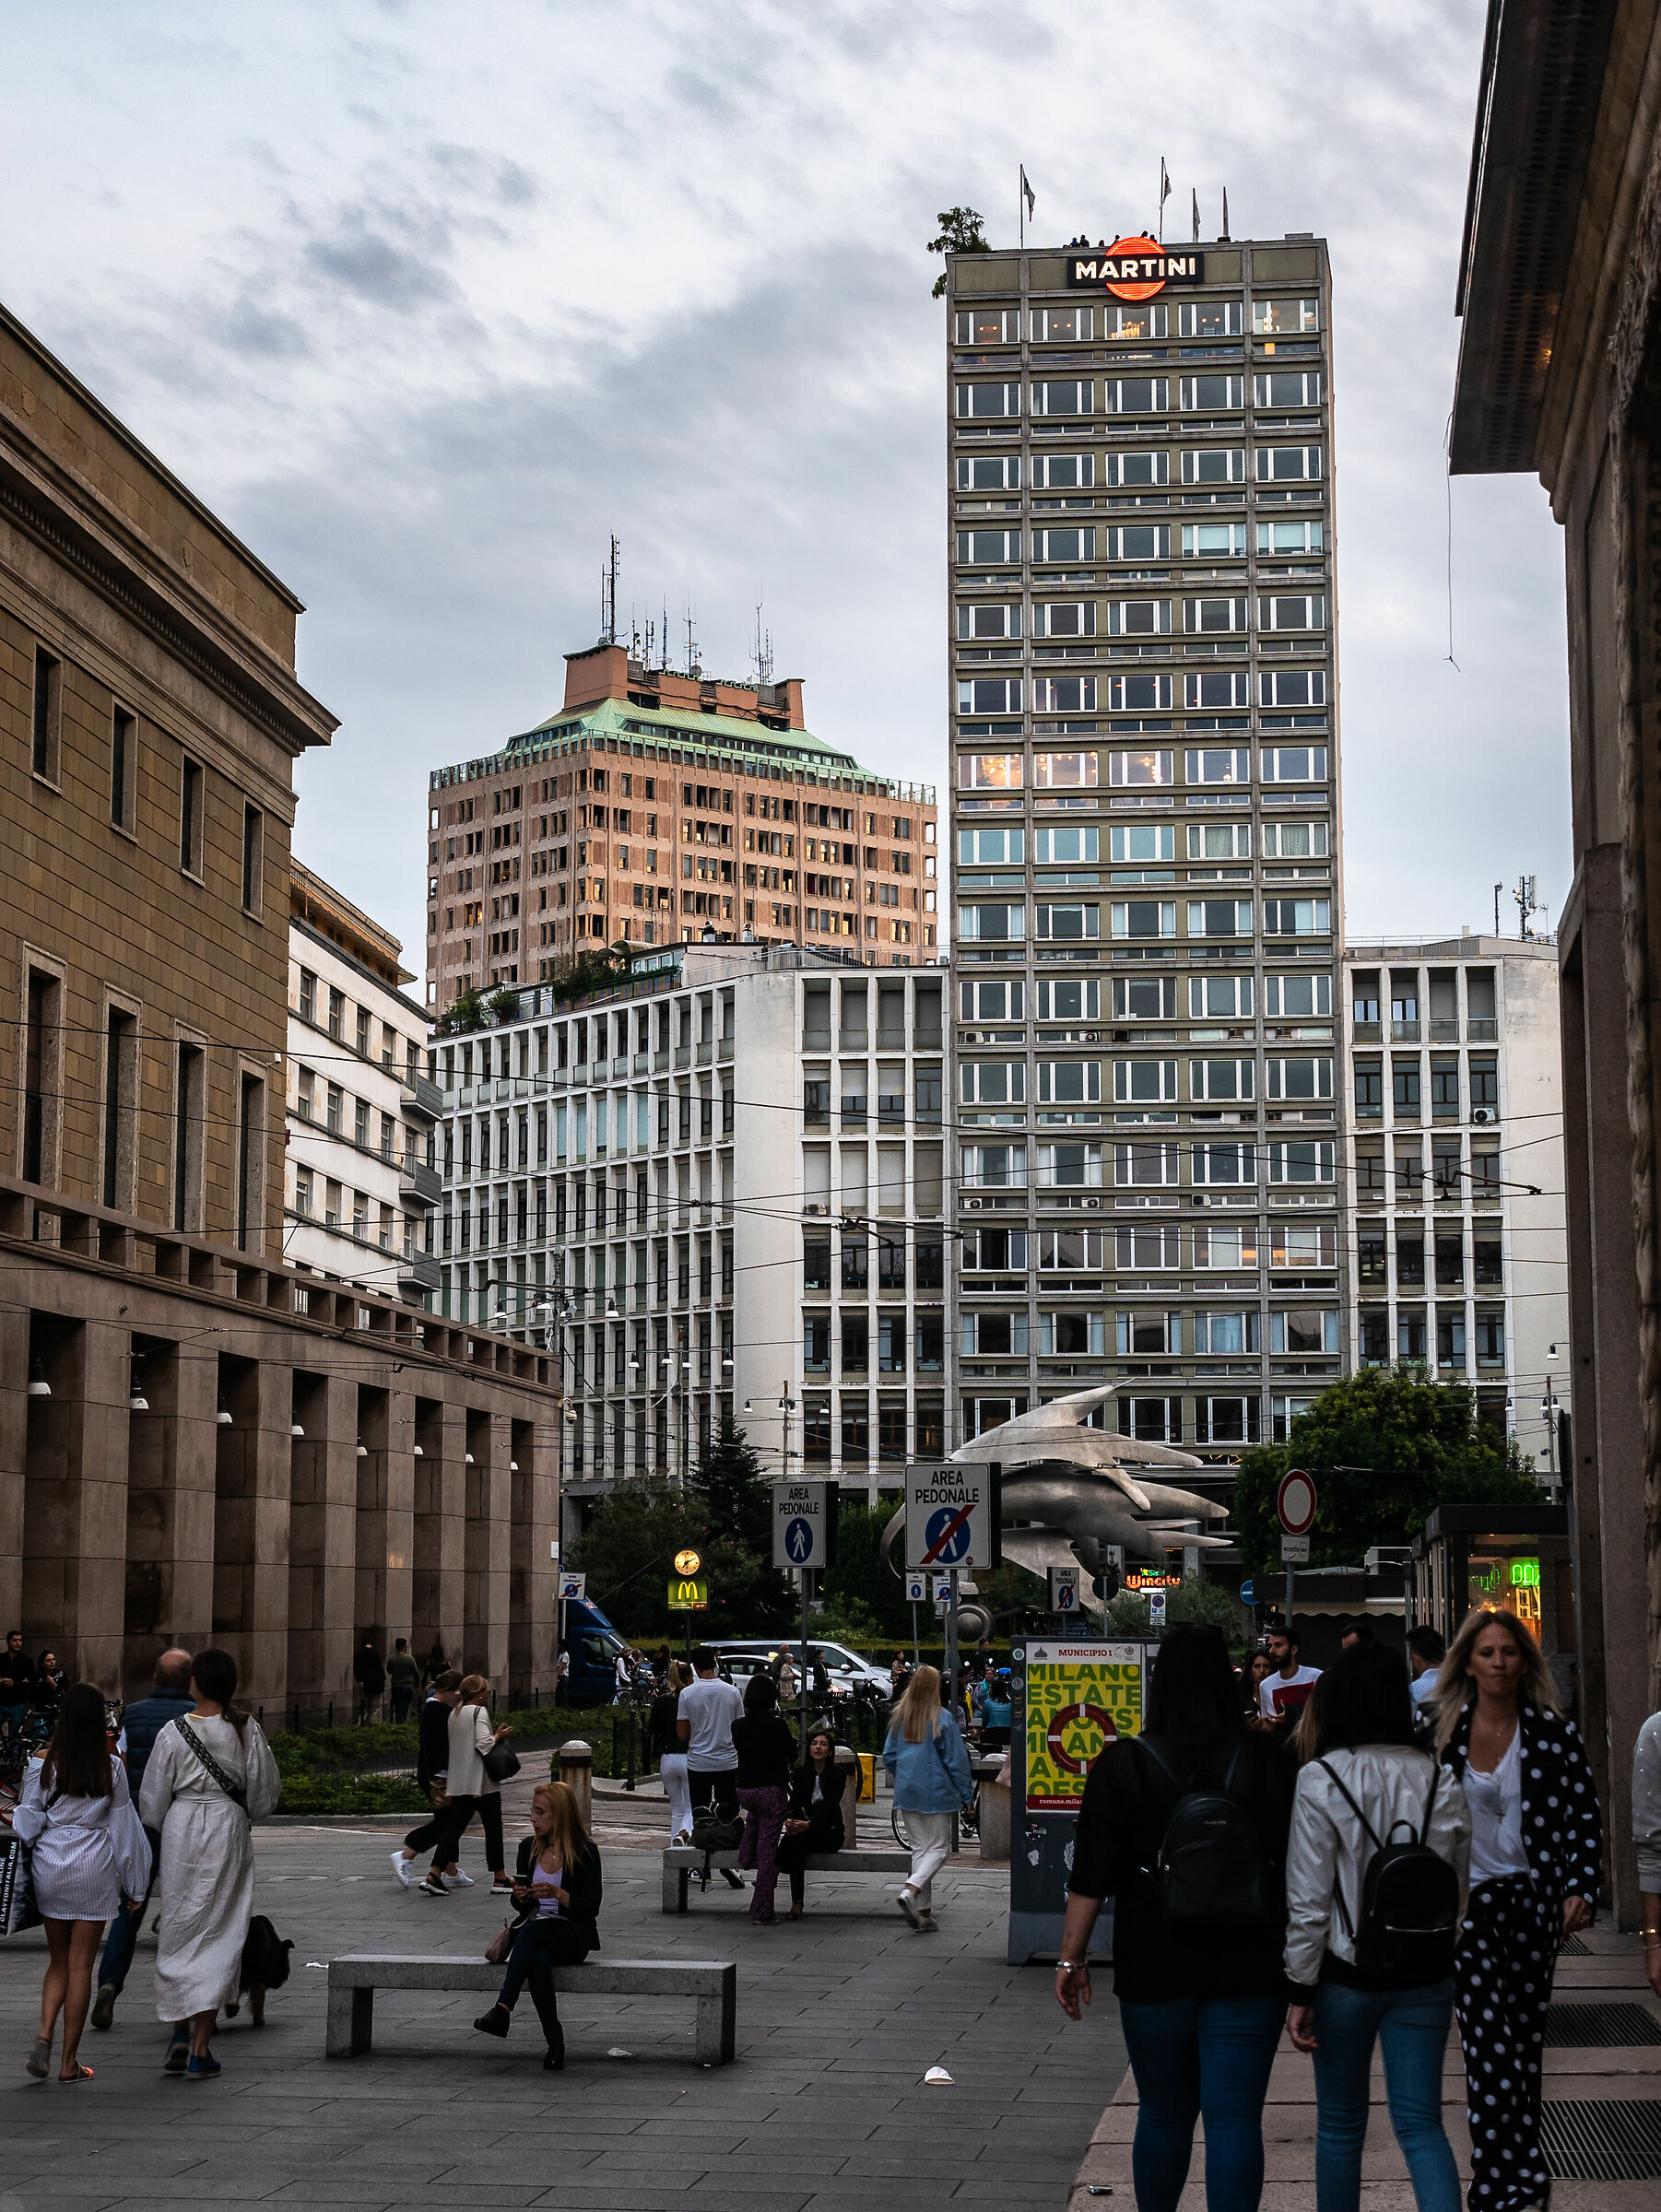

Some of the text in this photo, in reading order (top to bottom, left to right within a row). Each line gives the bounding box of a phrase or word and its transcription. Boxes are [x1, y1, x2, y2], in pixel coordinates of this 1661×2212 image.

[1076, 258, 1196, 279] MARTINI
[931, 1470, 964, 1486] AREA
[788, 1488, 809, 1500] AREA
[915, 1488, 980, 1504] PEDONALE
[779, 1502, 819, 1515] PEDONALE
[1054, 1577, 1077, 1585] PEDONALE
[1058, 1649, 1113, 1657] MUNICIPIO 1
[1027, 1664, 1141, 1682] MILANO
[1027, 1684, 1141, 1705] ESTATE
